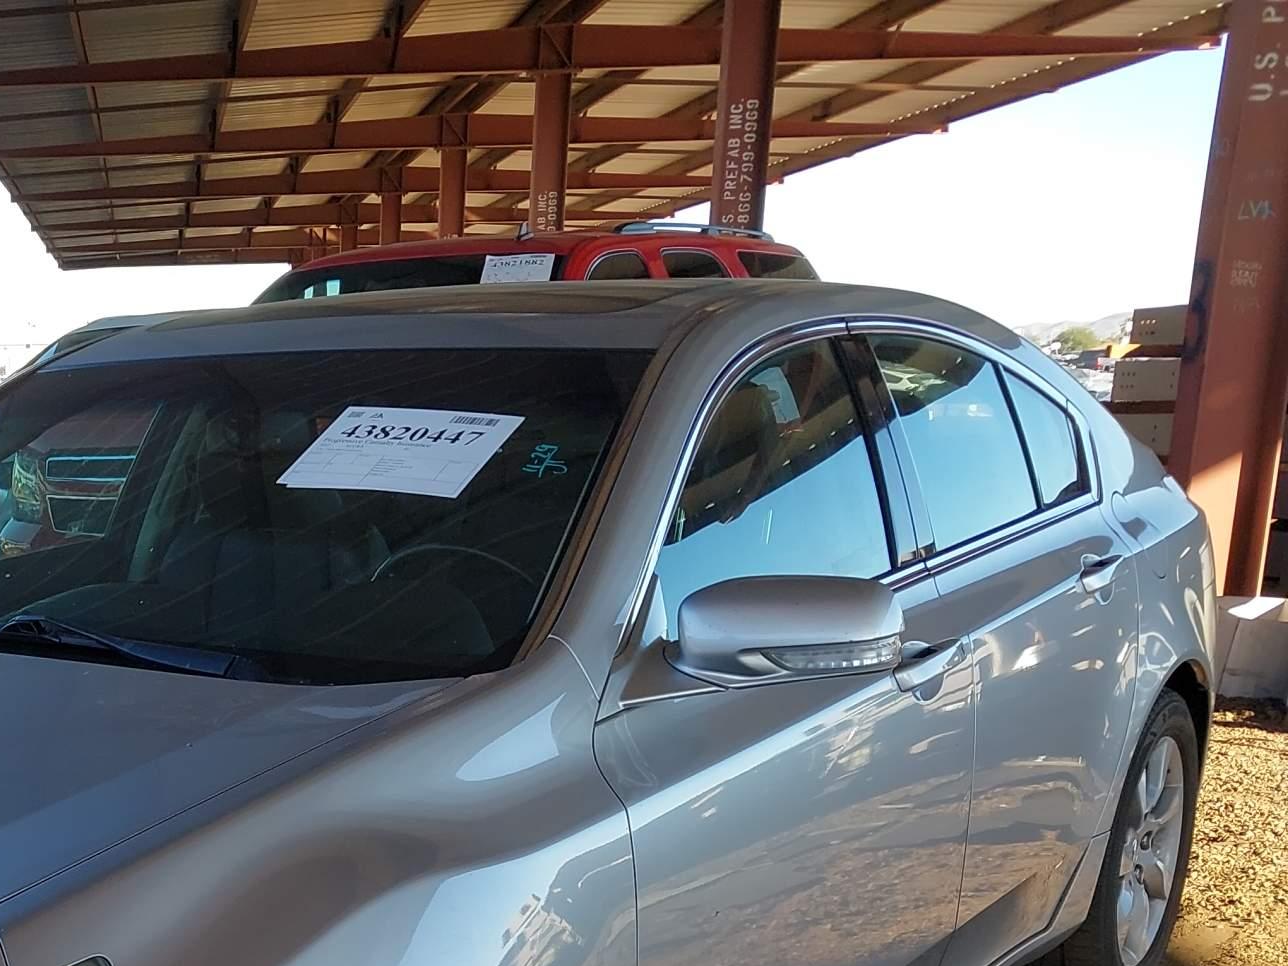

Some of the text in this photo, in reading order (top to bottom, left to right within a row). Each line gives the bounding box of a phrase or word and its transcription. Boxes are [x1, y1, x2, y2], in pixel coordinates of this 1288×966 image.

[1248, 42, 1281, 102] U.S.
[729, 98, 745, 128] INC.
[724, 138, 741, 200] PREFAB
[341, 423, 486, 447] 43820447
